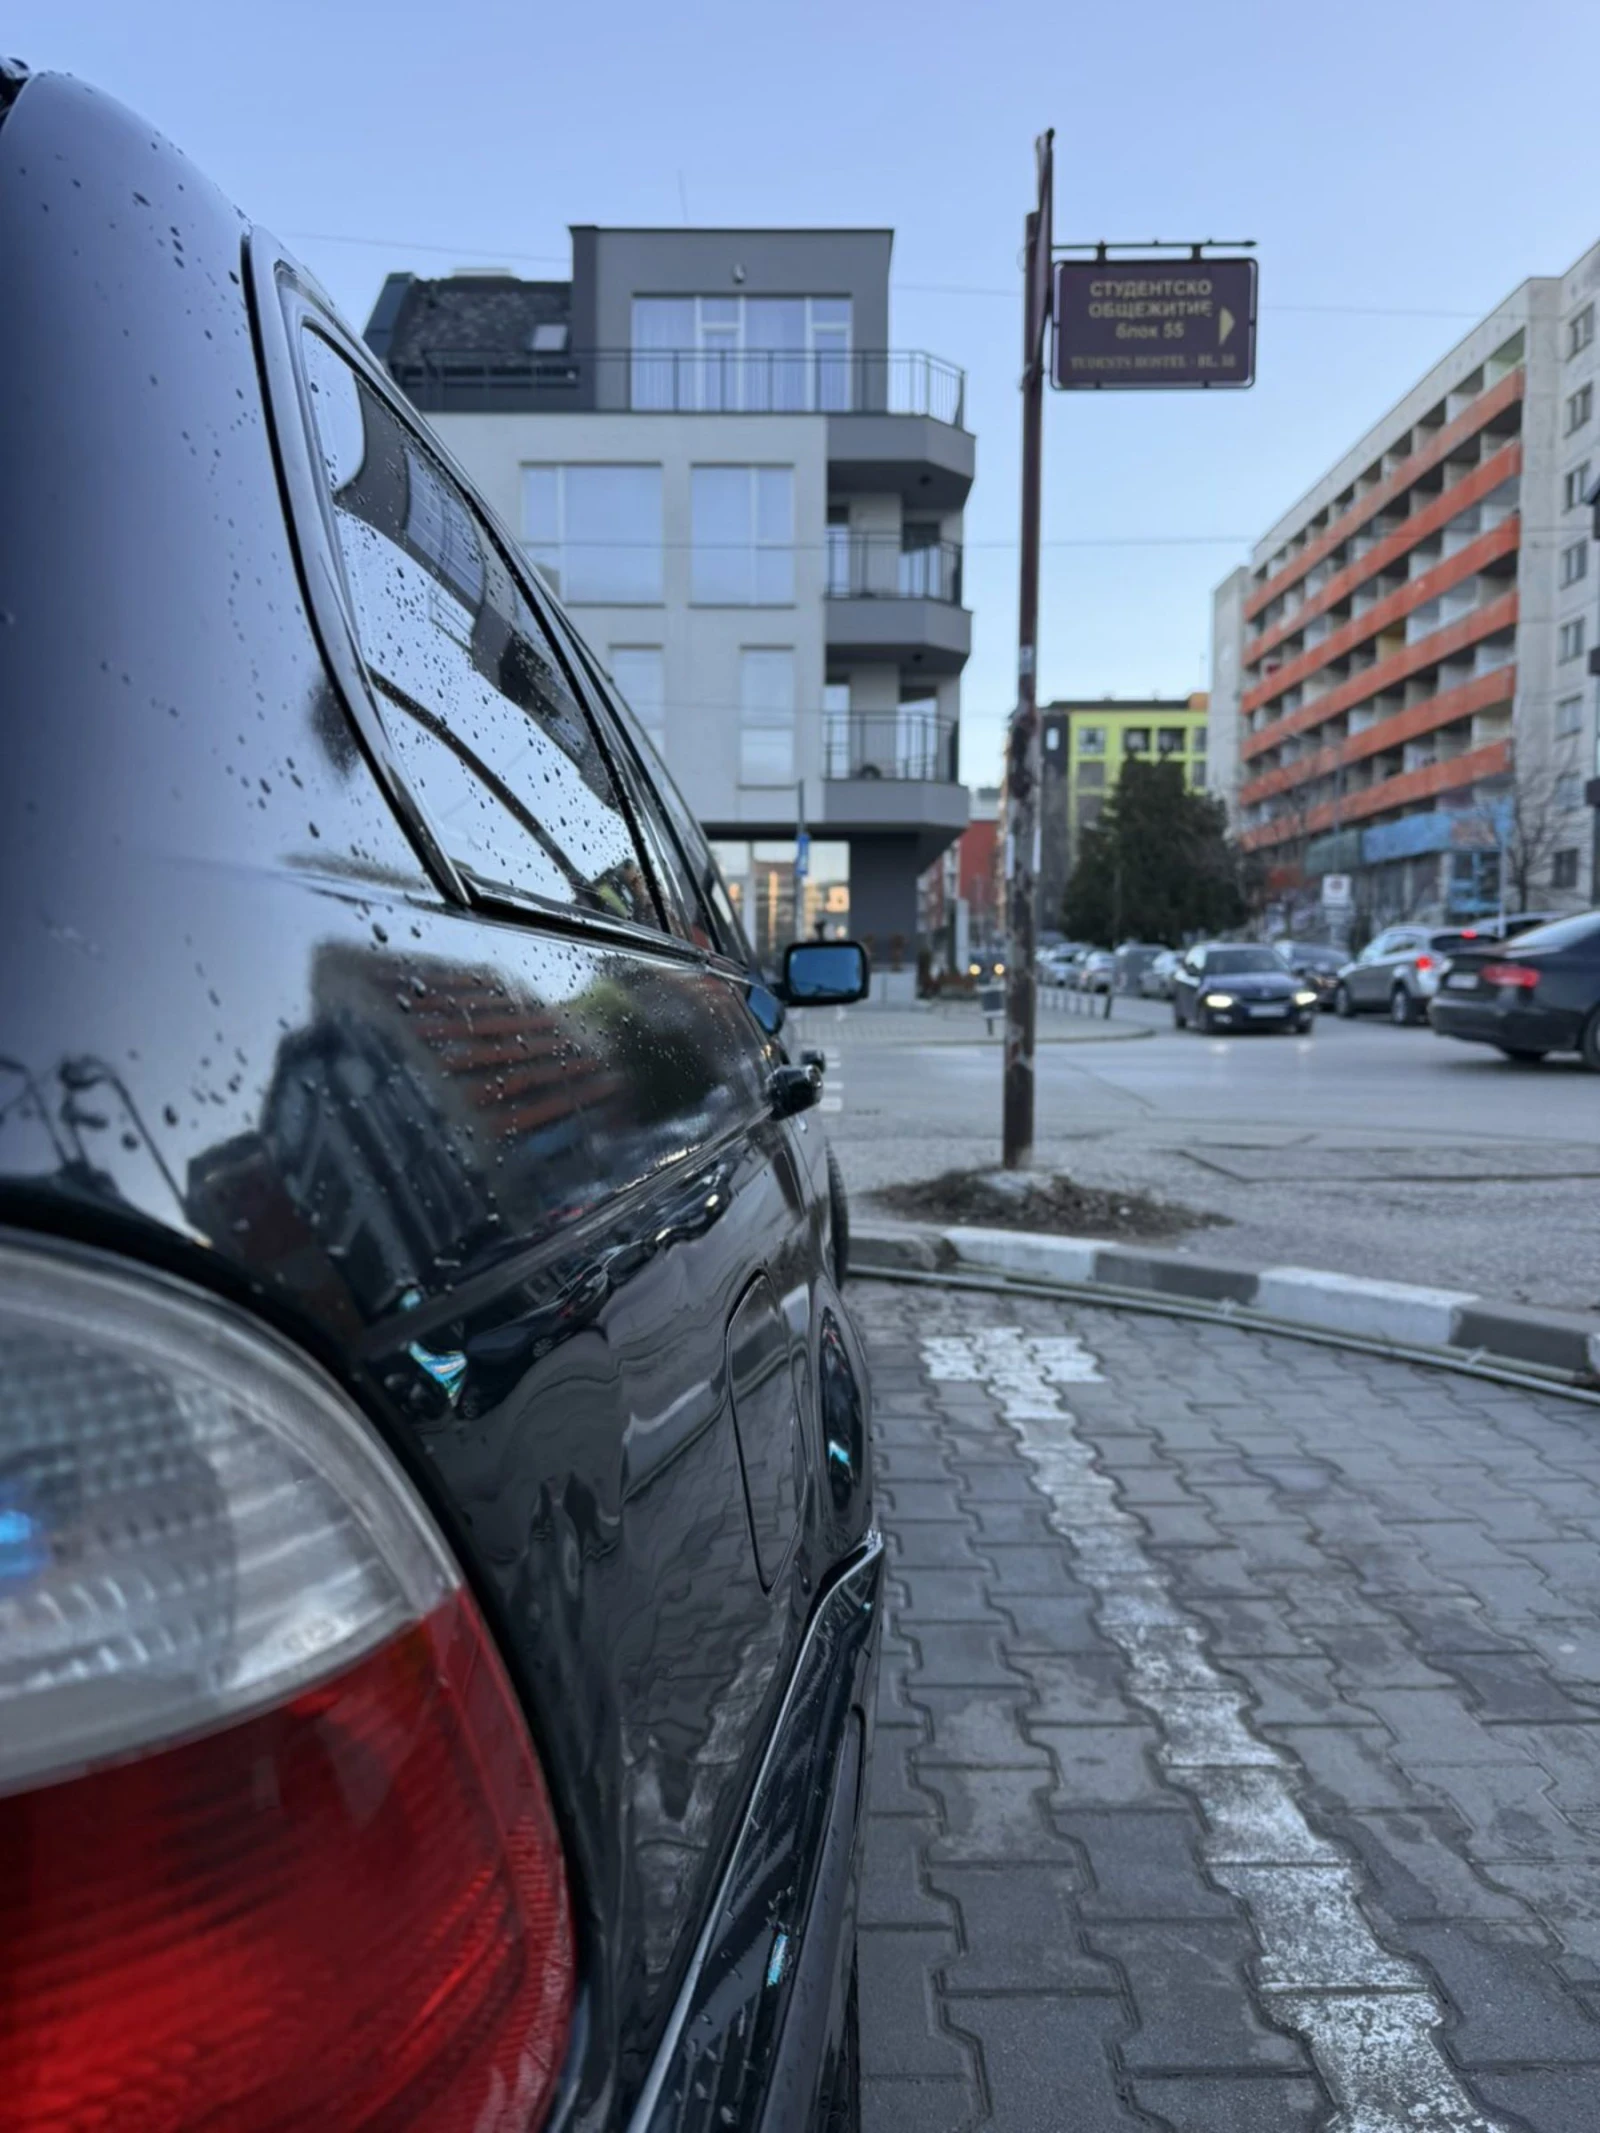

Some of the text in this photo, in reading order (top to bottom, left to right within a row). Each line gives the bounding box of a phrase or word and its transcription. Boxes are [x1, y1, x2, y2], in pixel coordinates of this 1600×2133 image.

[1089, 280, 1212, 298] СТУДЕНТСКО
[1088, 300, 1213, 318] ОБЩЕЖИТИЕ
[1163, 321, 1185, 339] 55
